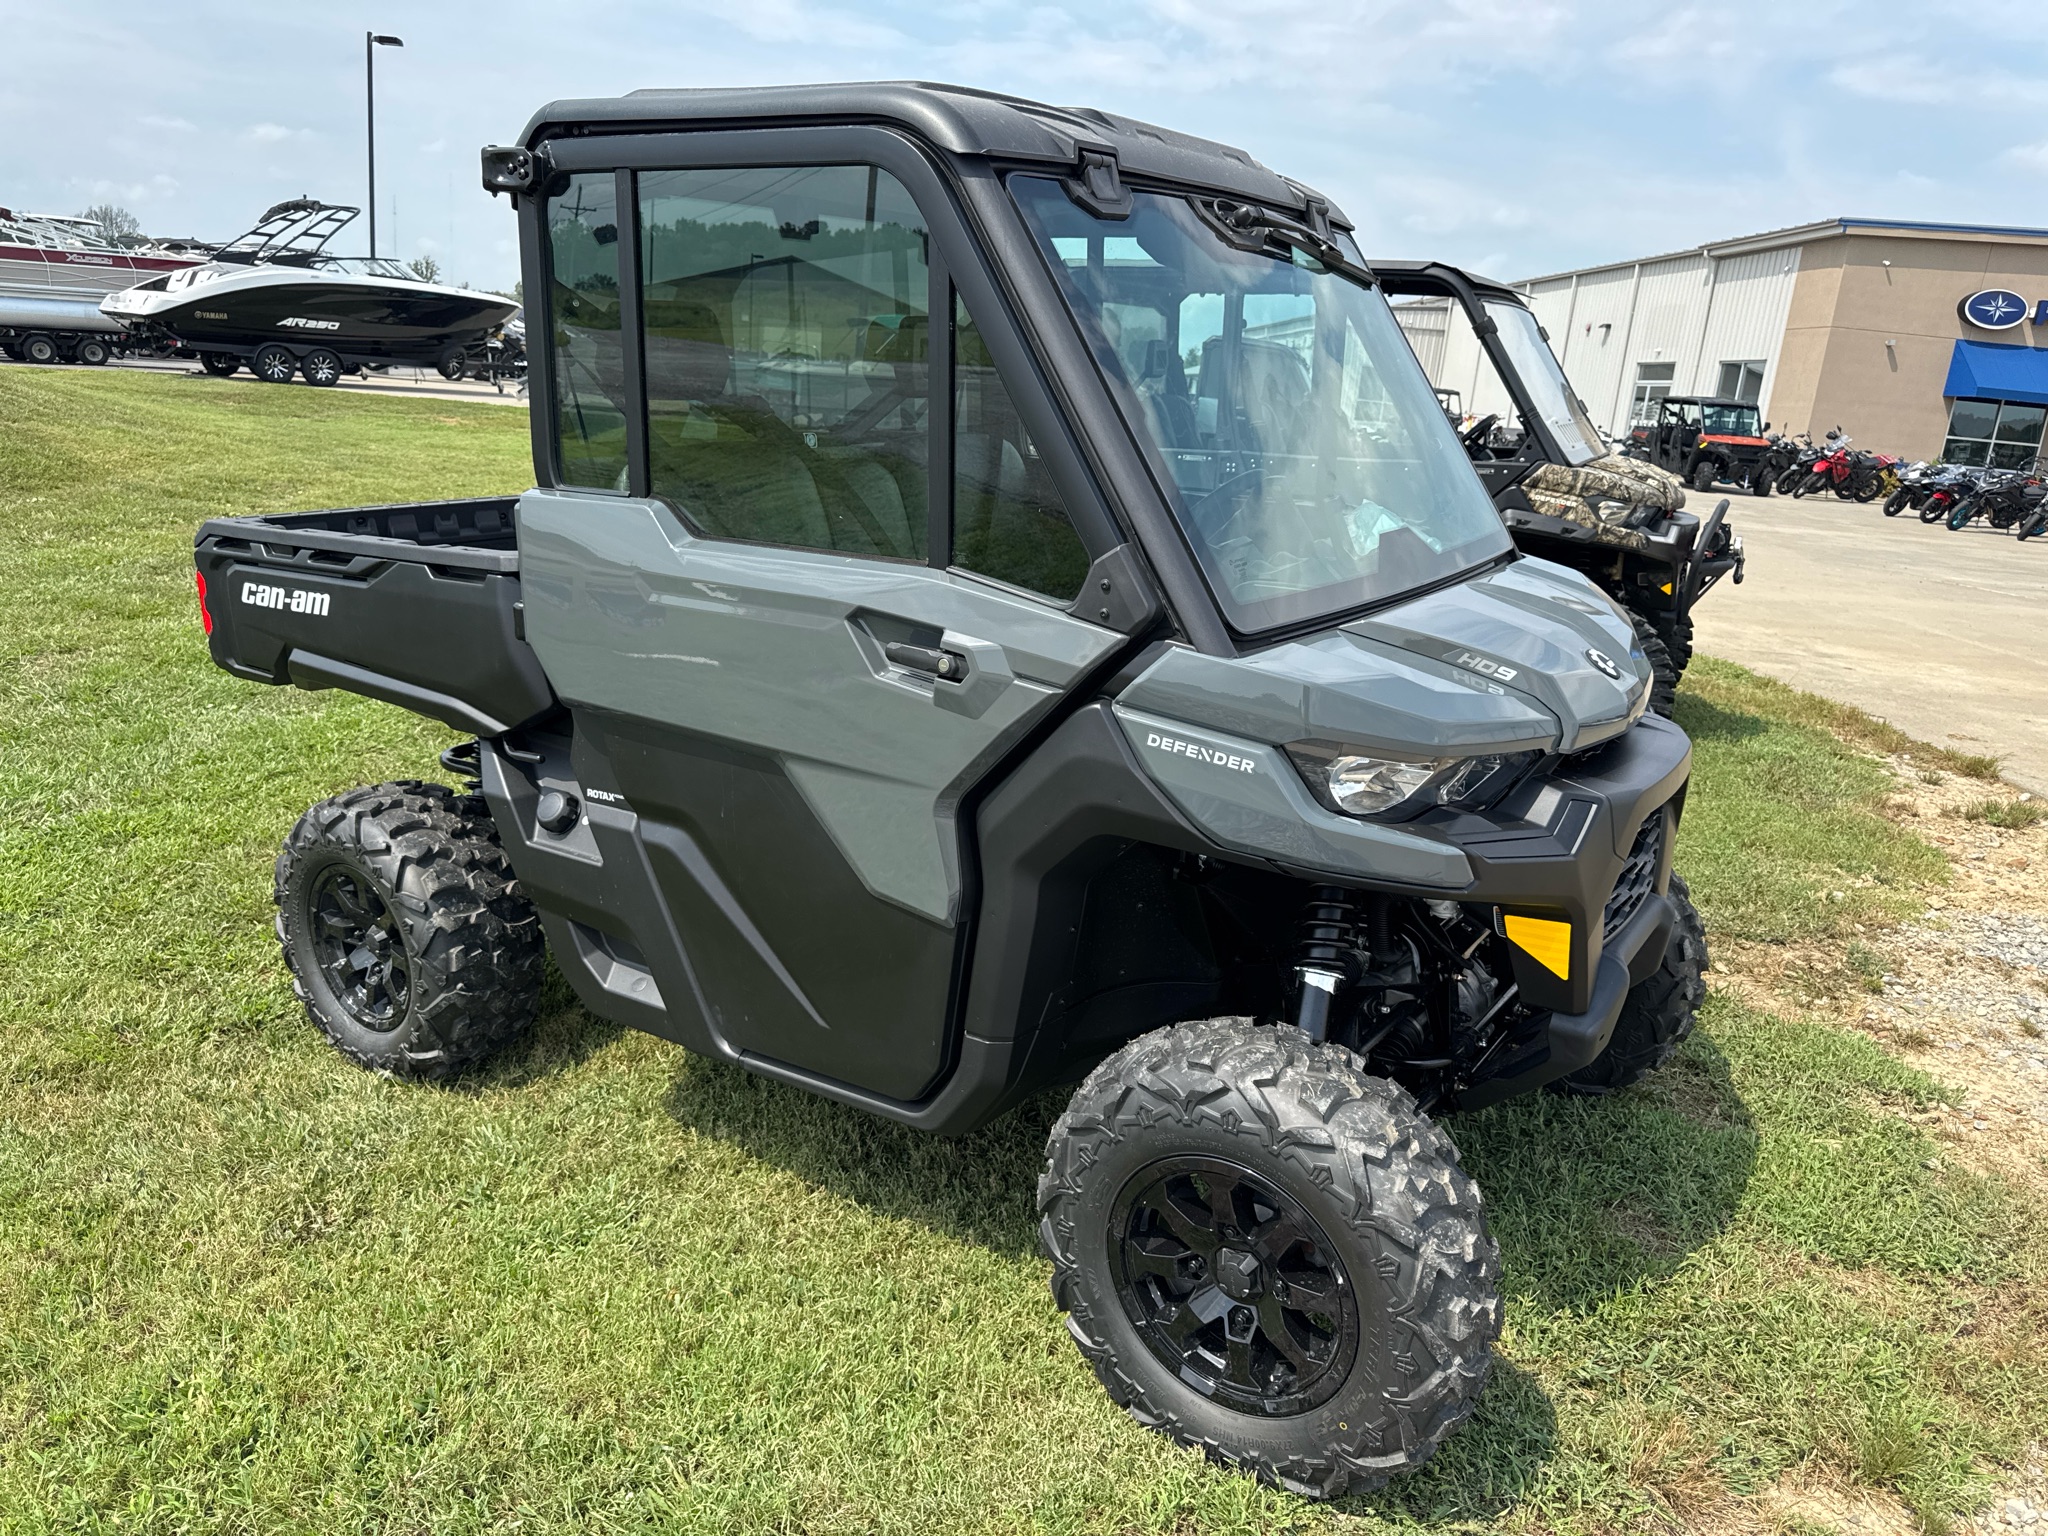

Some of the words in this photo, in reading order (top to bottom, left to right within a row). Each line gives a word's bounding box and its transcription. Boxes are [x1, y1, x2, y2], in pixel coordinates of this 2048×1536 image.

[202, 311, 228, 320] YAMAHA
[276, 316, 341, 330] AR250
[1534, 494, 1578, 508] DEFENDER
[241, 581, 331, 617] can-am
[1456, 652, 1518, 682] HD9
[1146, 733, 1255, 774] DEFENDER
[586, 788, 615, 802] ROTAX
